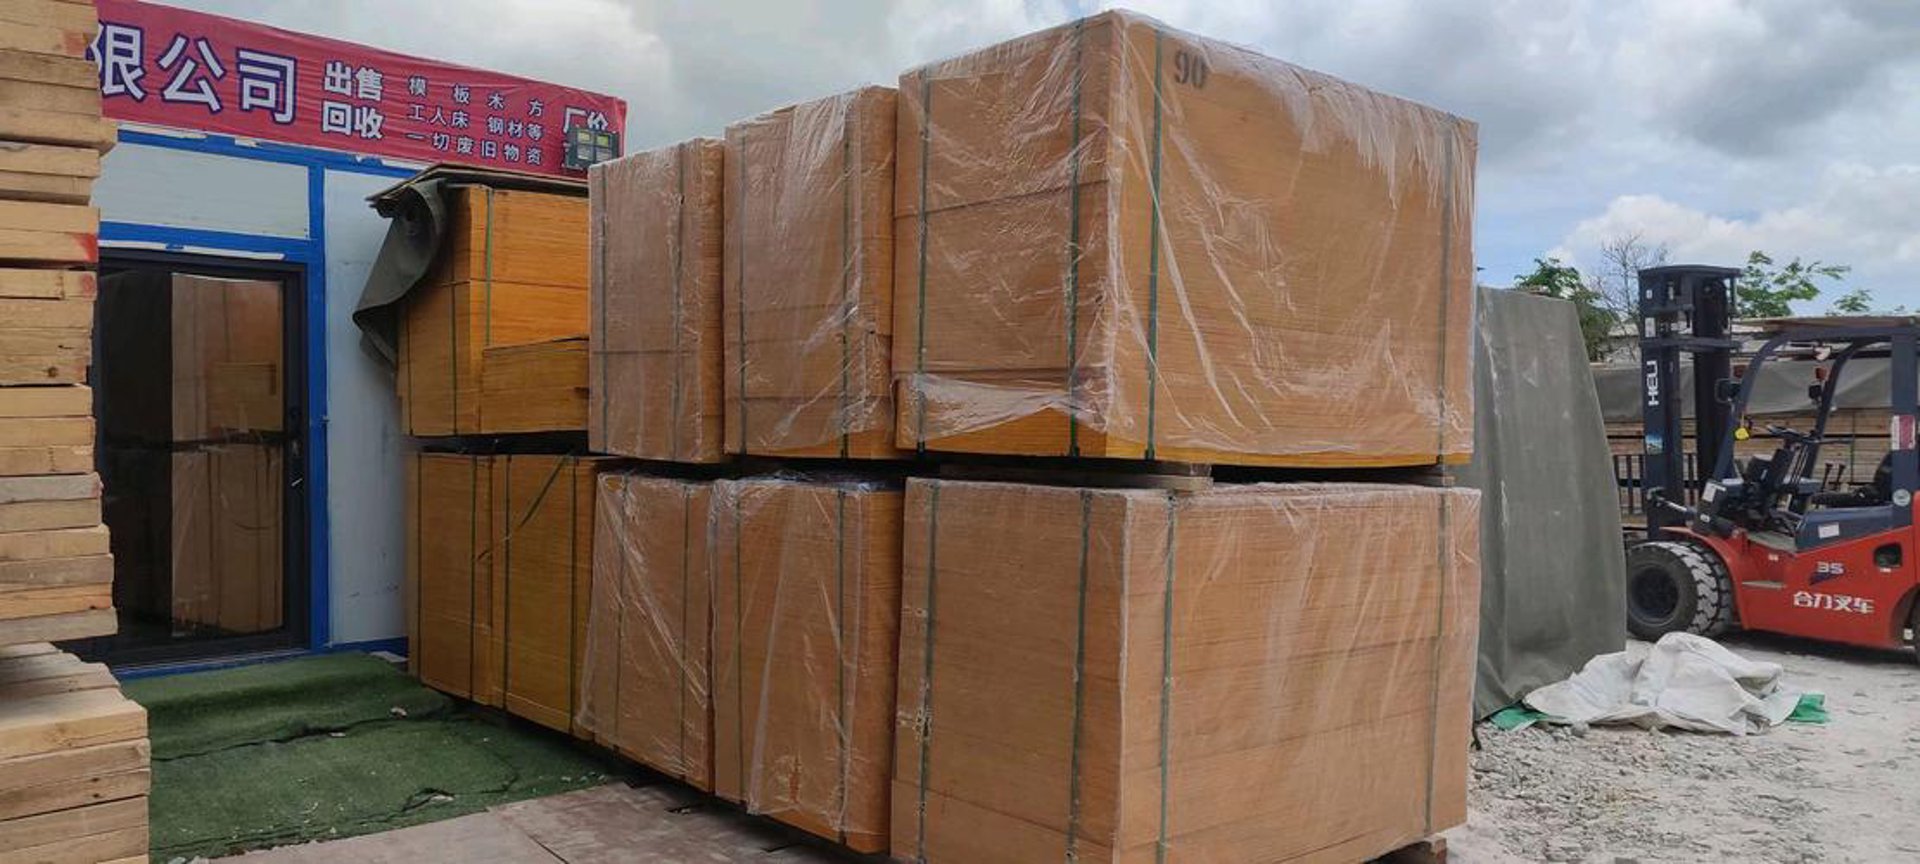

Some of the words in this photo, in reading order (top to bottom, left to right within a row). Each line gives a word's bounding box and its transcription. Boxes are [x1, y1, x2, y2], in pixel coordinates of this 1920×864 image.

[89, 22, 297, 124] 限公司
[323, 61, 383, 101] 出售
[1174, 50, 1208, 89] 90
[322, 101, 384, 139] 回收
[405, 132, 543, 166] 一切废旧物资
[1793, 590, 1876, 614] 合力叉车
